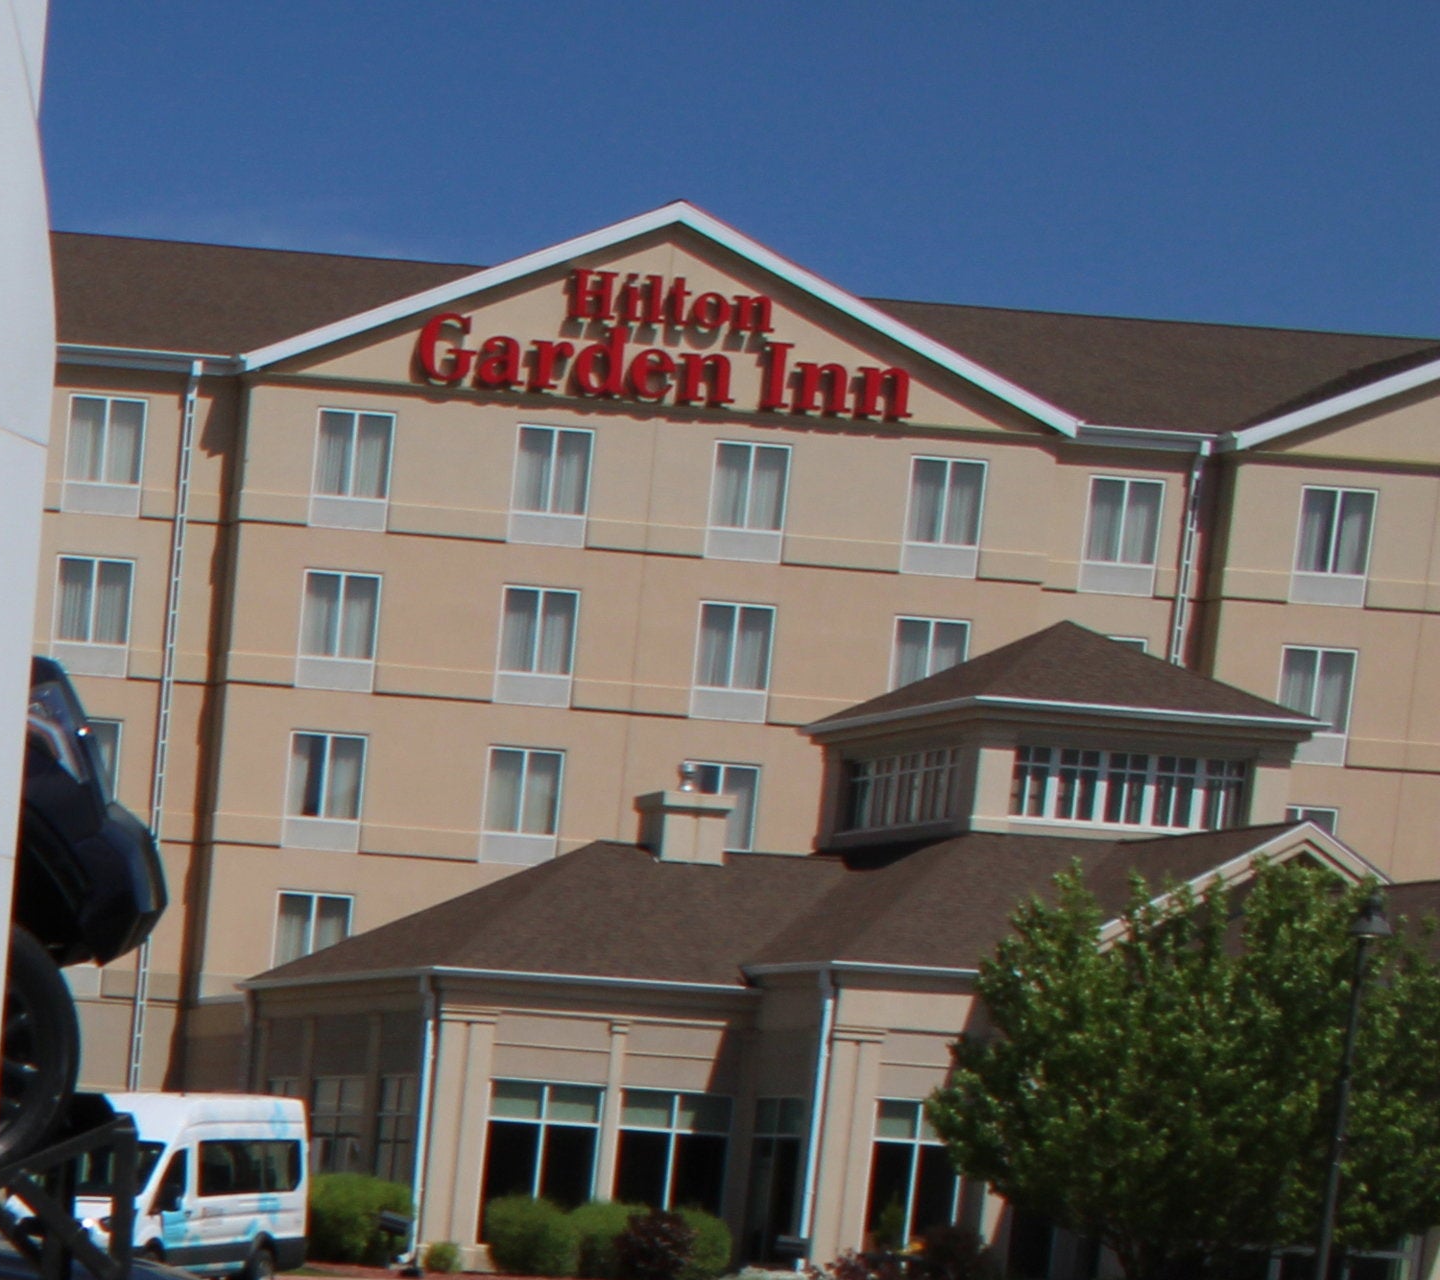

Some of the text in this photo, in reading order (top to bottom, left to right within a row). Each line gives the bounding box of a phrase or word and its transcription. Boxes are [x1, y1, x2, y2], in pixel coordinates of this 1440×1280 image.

[569, 267, 774, 334] Hilton
[418, 312, 913, 420] Garden Inn
